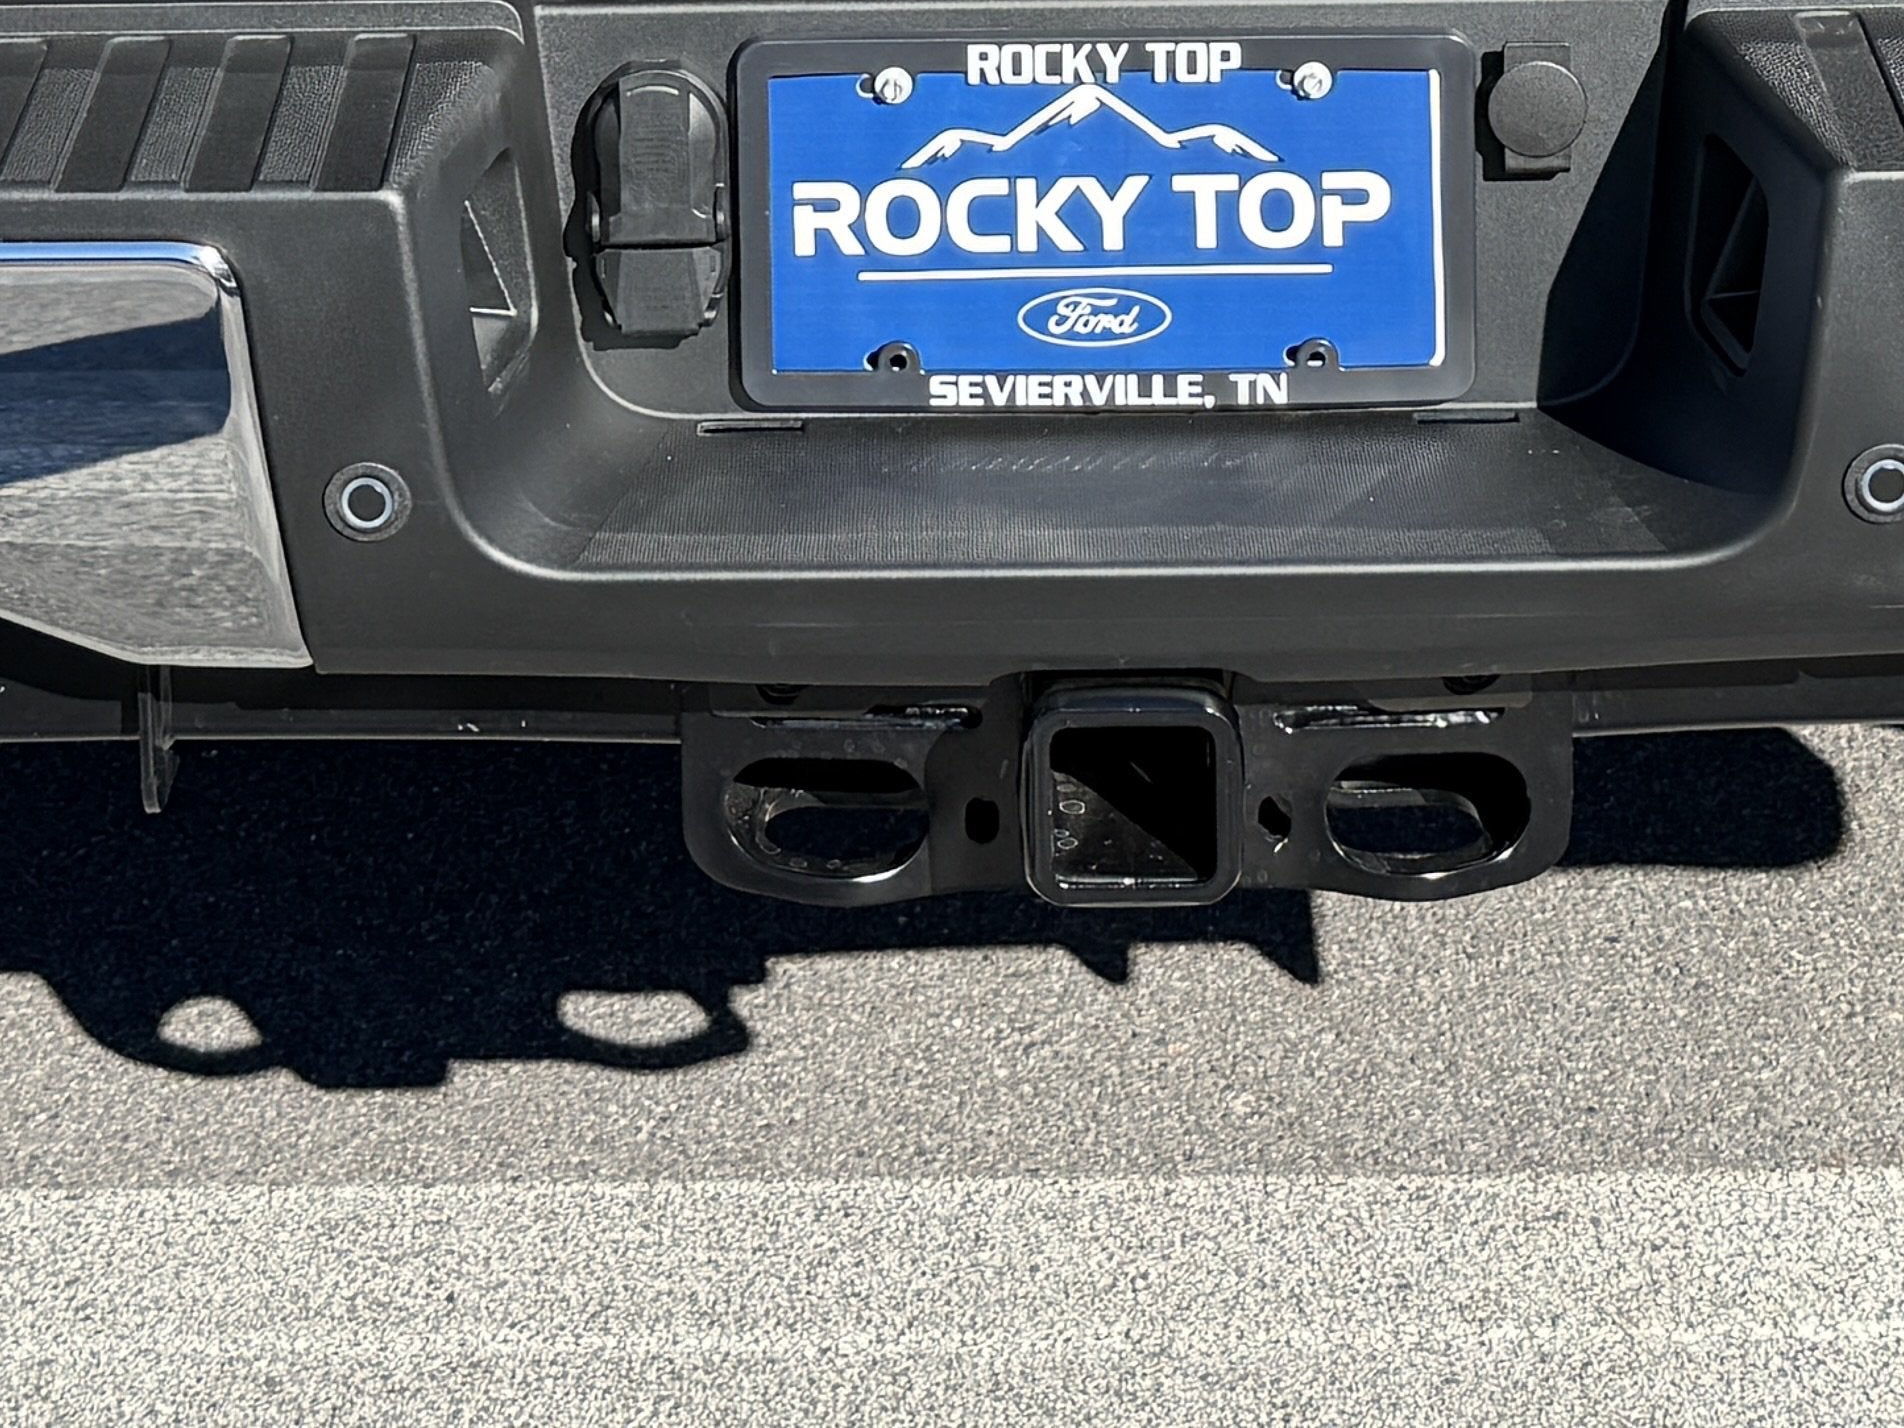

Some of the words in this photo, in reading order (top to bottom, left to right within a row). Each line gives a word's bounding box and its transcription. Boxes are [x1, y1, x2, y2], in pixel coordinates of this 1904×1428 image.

[966, 43, 1128, 86] ROCKY
[1145, 42, 1243, 83] TOP
[793, 175, 1154, 258] ROCKY
[1172, 171, 1392, 250] TOP
[1047, 297, 1140, 337] Ford
[929, 375, 1216, 409] SEVIERVILLE,
[1230, 373, 1288, 406] TN
